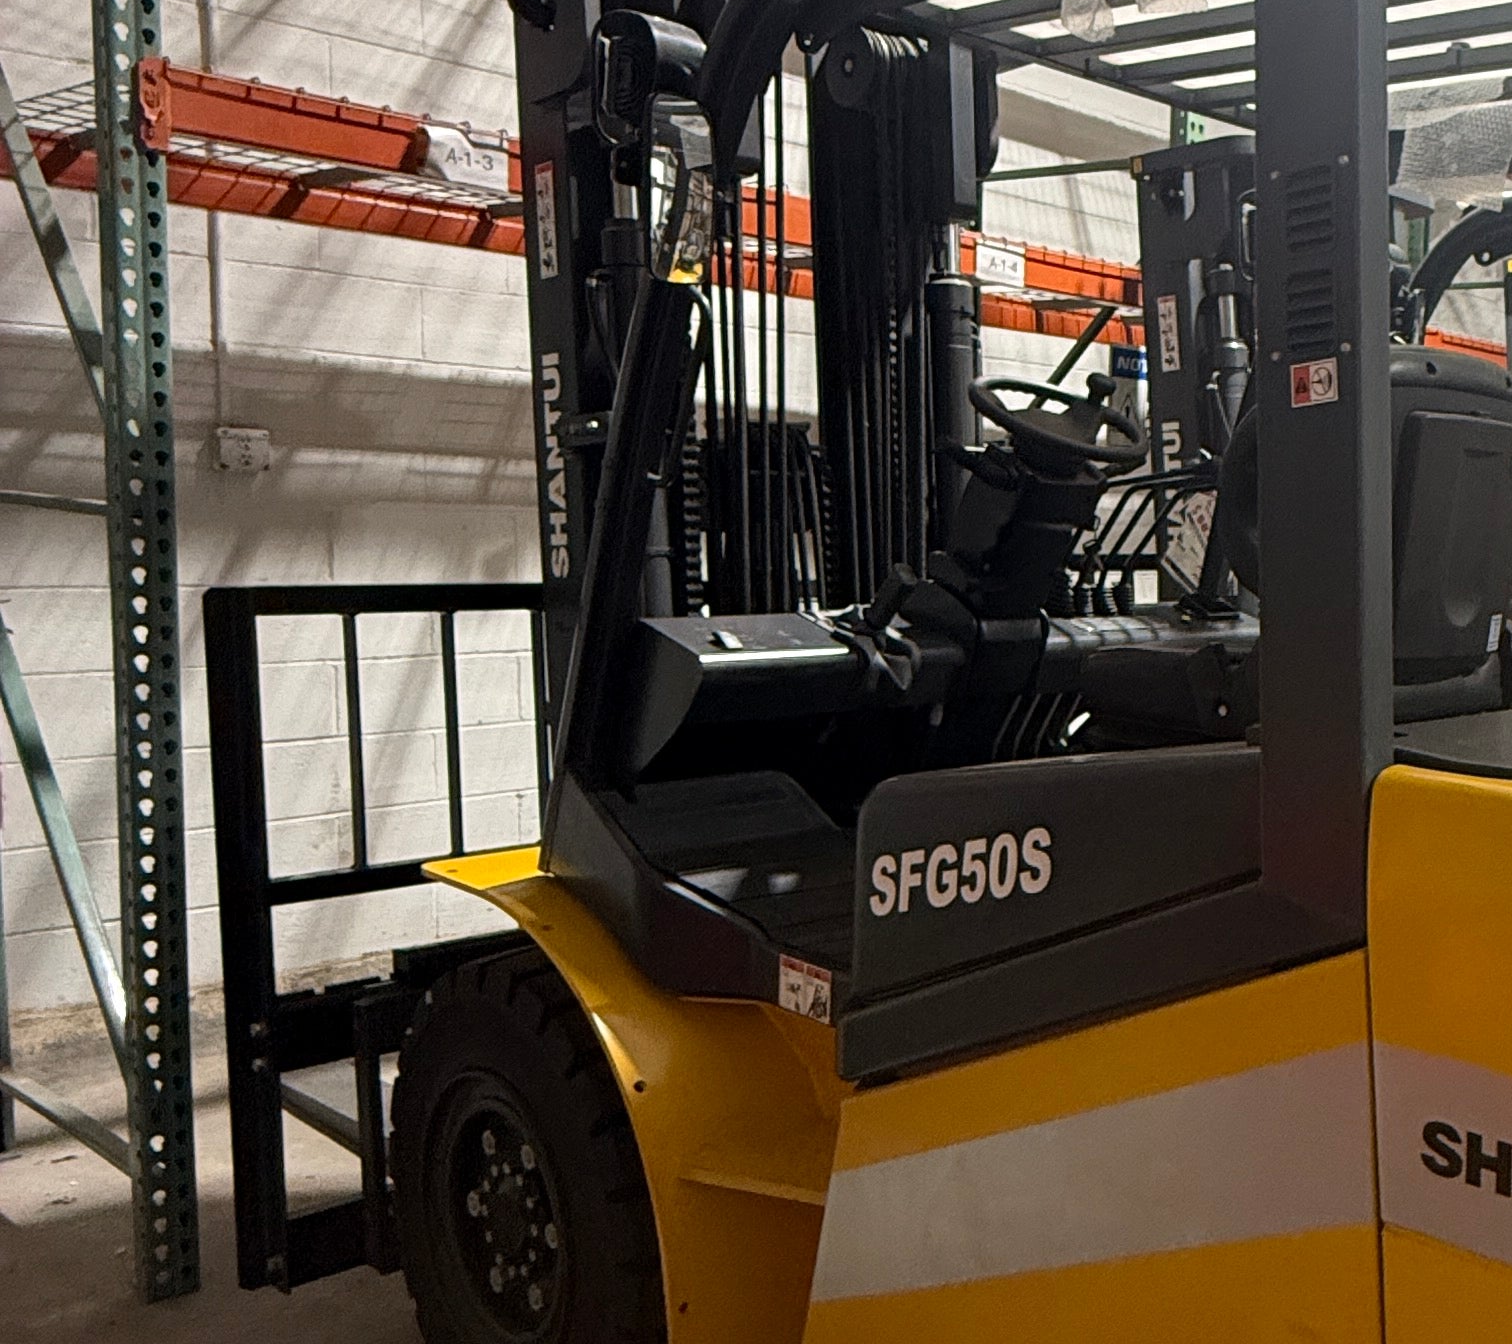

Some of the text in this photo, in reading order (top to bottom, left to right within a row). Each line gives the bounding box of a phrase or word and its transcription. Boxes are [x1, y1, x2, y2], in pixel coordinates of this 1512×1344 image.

[445, 147, 494, 171] A-1-3
[541, 352, 570, 579] SHANTUI
[869, 827, 1051, 917] SFG50S
